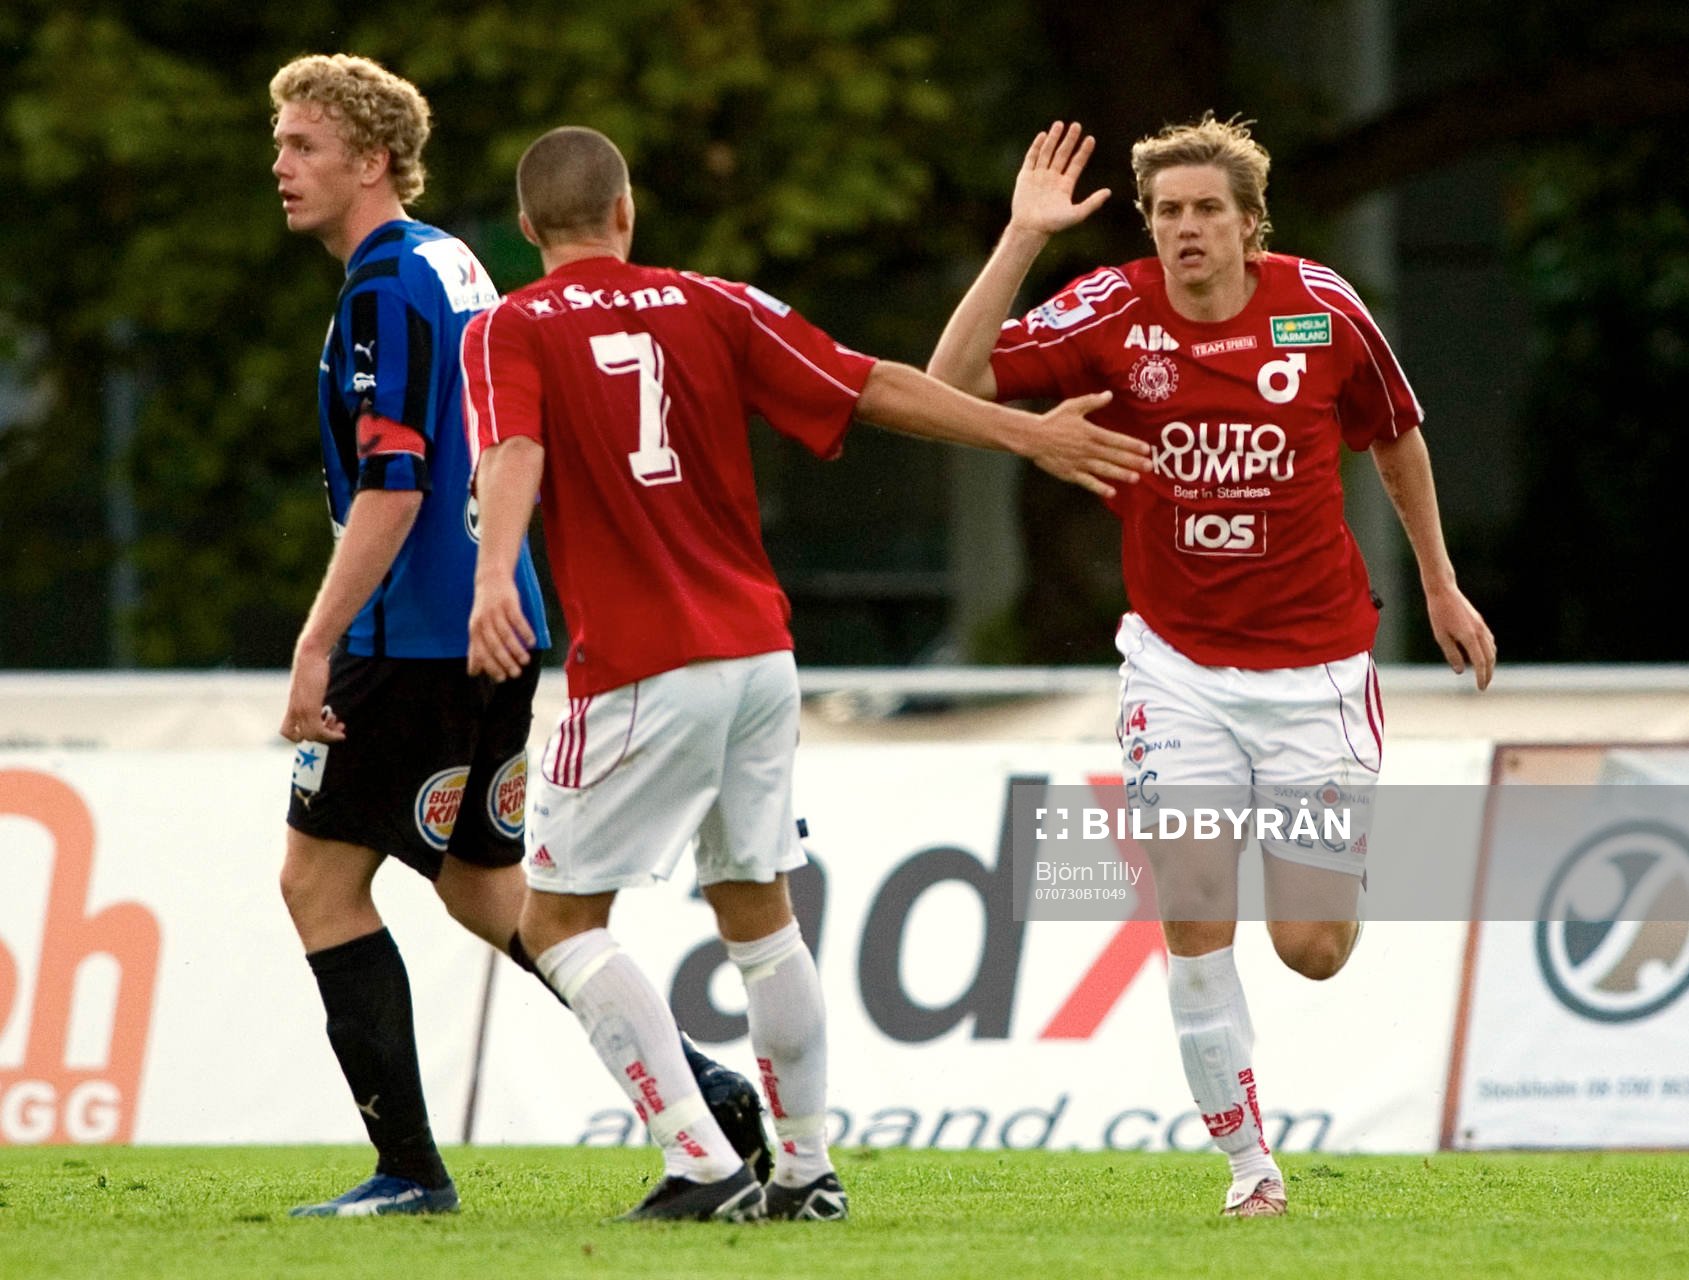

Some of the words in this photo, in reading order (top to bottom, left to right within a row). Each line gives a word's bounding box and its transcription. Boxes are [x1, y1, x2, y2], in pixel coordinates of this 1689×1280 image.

[1194, 341, 1225, 355] TEAM
[589, 331, 682, 487] 7
[1160, 421, 1286, 457] OUTO
[1151, 444, 1296, 484] KUMPU
[1174, 485, 1199, 500] Best
[1202, 488, 1213, 499] in
[1217, 486, 1272, 499] Stainless
